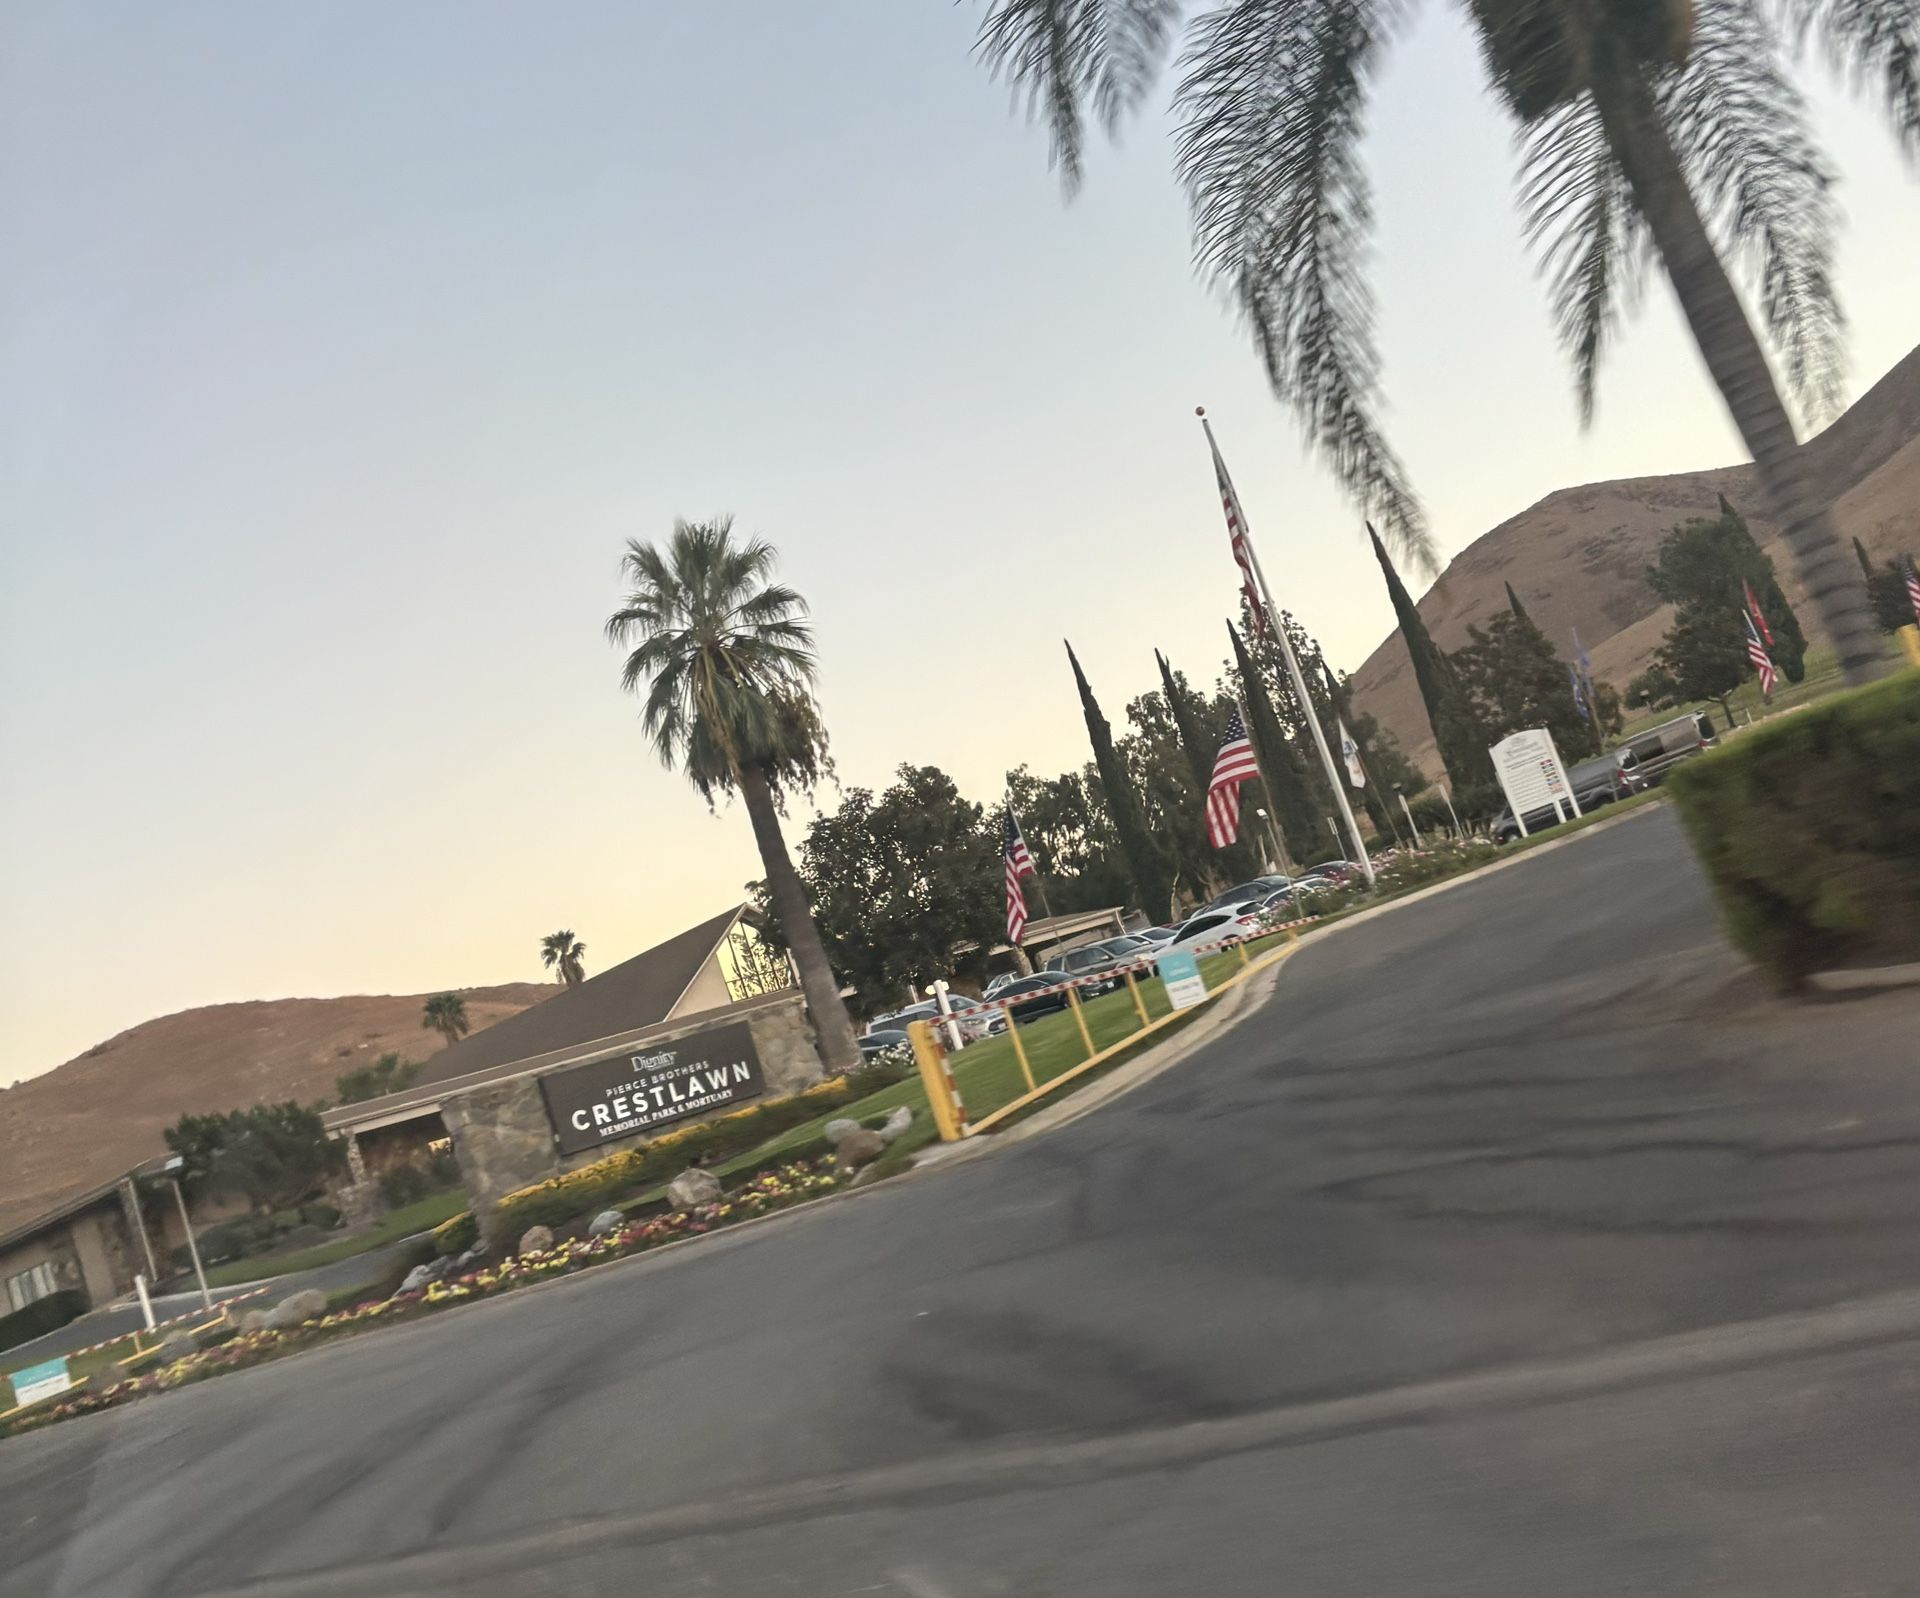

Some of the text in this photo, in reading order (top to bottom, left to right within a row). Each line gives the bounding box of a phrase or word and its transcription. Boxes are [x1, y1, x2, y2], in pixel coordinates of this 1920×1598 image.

[605, 1061, 709, 1097] PIERCE BROTHERS
[631, 1051, 676, 1072] Dignity
[571, 1061, 751, 1131] CRESTLAWN
[599, 1089, 734, 1137] MEMORIAL PARK & MORTUARY
